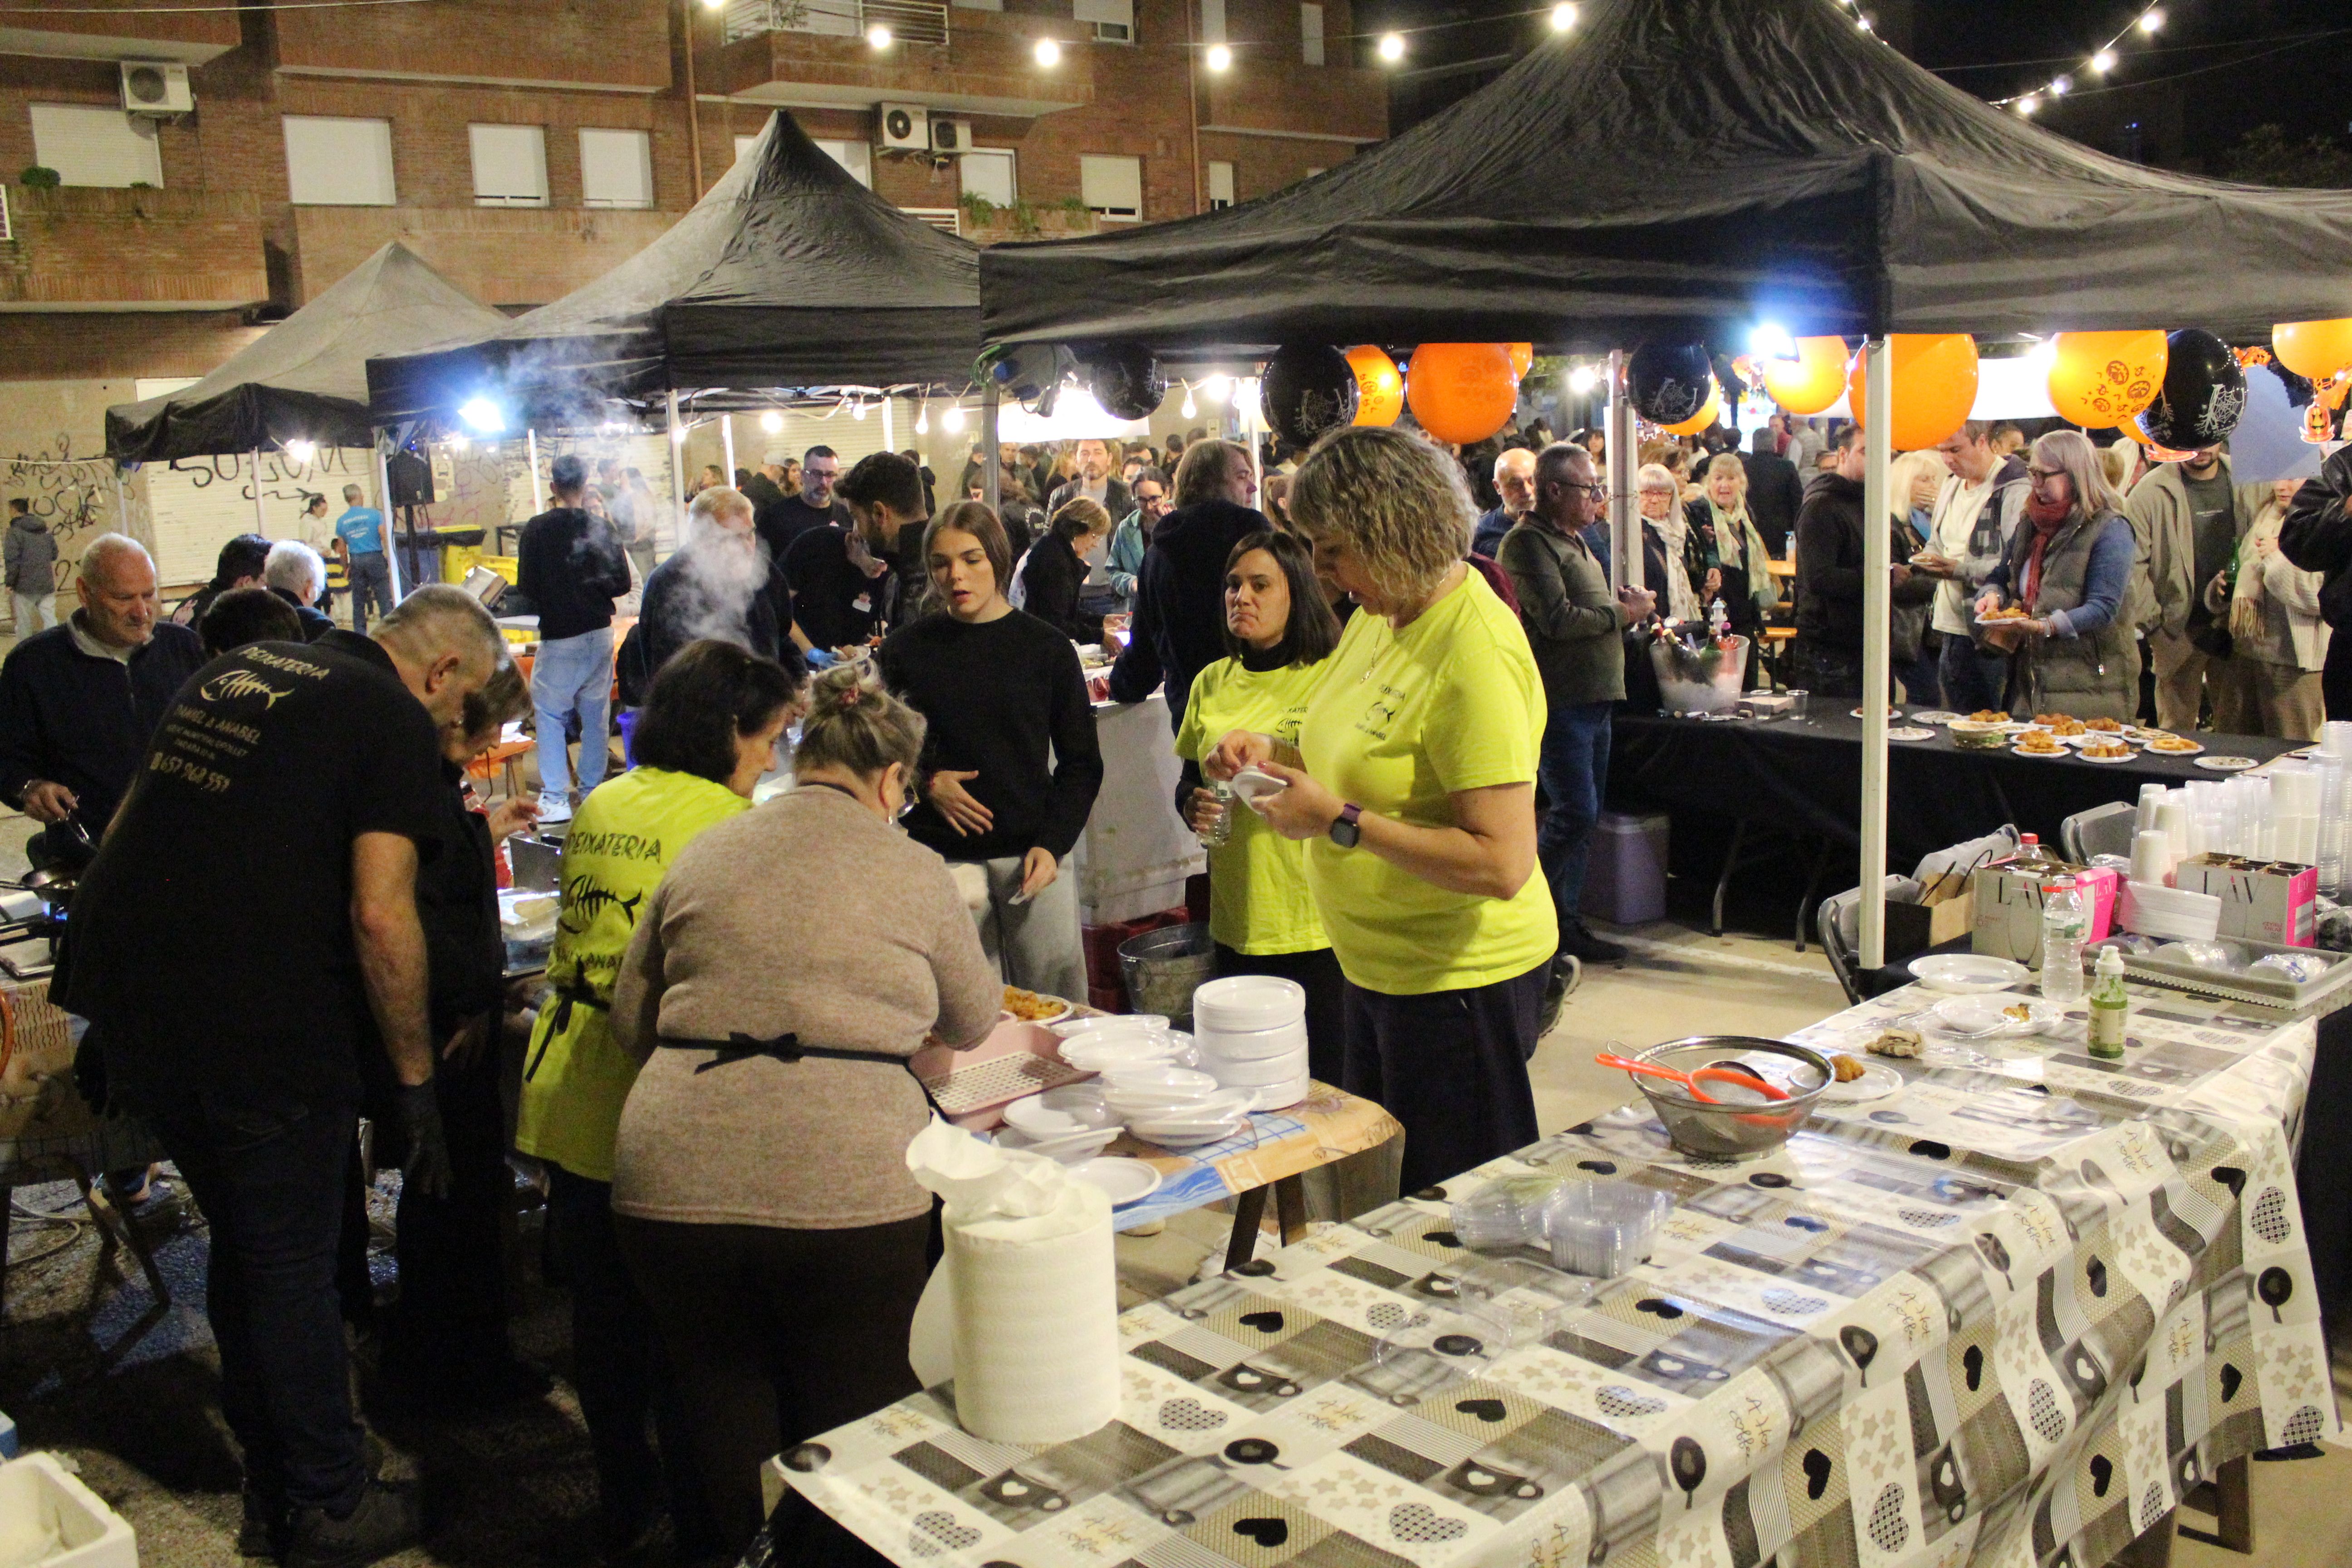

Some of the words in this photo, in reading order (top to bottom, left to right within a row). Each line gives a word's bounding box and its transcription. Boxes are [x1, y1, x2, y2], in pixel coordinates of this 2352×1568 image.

[239, 646, 330, 680] PEIXATERIA
[216, 719, 261, 745] ANABEL
[2204, 871, 2264, 904] LAV
